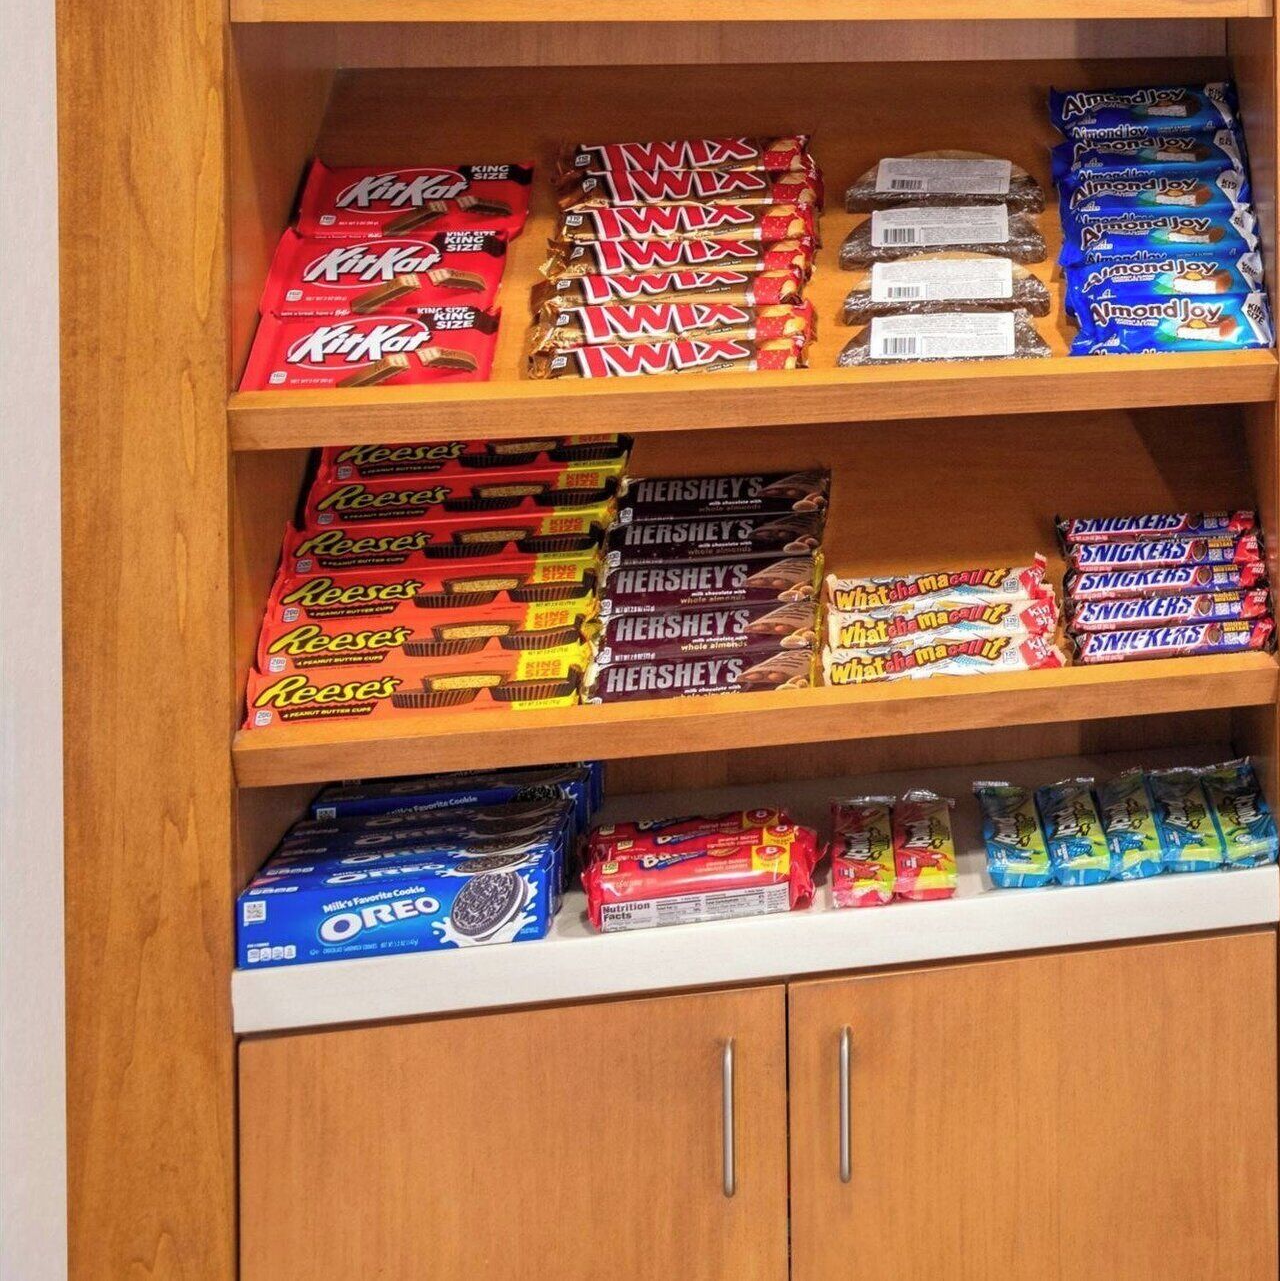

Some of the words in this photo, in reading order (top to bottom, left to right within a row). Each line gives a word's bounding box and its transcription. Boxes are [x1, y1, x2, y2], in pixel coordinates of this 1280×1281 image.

[1062, 90, 1147, 119] Almond
[1149, 88, 1186, 105] Joy
[581, 138, 758, 171] TWIX
[471, 165, 510, 173] KING
[586, 169, 766, 205] TWIX
[1070, 179, 1156, 210] Almond
[1156, 178, 1198, 191] Joy
[444, 236, 484, 244] KING
[446, 244, 483, 252] SIZE
[434, 312, 475, 320] KING
[436, 320, 474, 329] SIZE
[318, 484, 453, 511] Reese's
[637, 476, 764, 502] HERSHEY'S
[625, 520, 754, 546] HERSHEY'S
[1074, 514, 1184, 534] SNICKERS
[295, 530, 431, 557] Reese's
[1080, 541, 1187, 563] SNICKERS
[616, 564, 749, 594] HERSHEY'S
[1080, 568, 1192, 590] SNICKERS
[681, 643, 708, 651] whole
[303, 657, 332, 666] PEANUT
[334, 656, 362, 664] BUTTER
[290, 709, 320, 718] PEANUT
[322, 707, 350, 716] BUTTER
[351, 706, 371, 714] CUPS
[323, 901, 352, 914] Milk's
[353, 889, 391, 906] Favorite
[392, 885, 426, 897] Cookie
[603, 902, 650, 914] Nutrition
[320, 897, 441, 944] OREO
[603, 913, 632, 921] Facts
